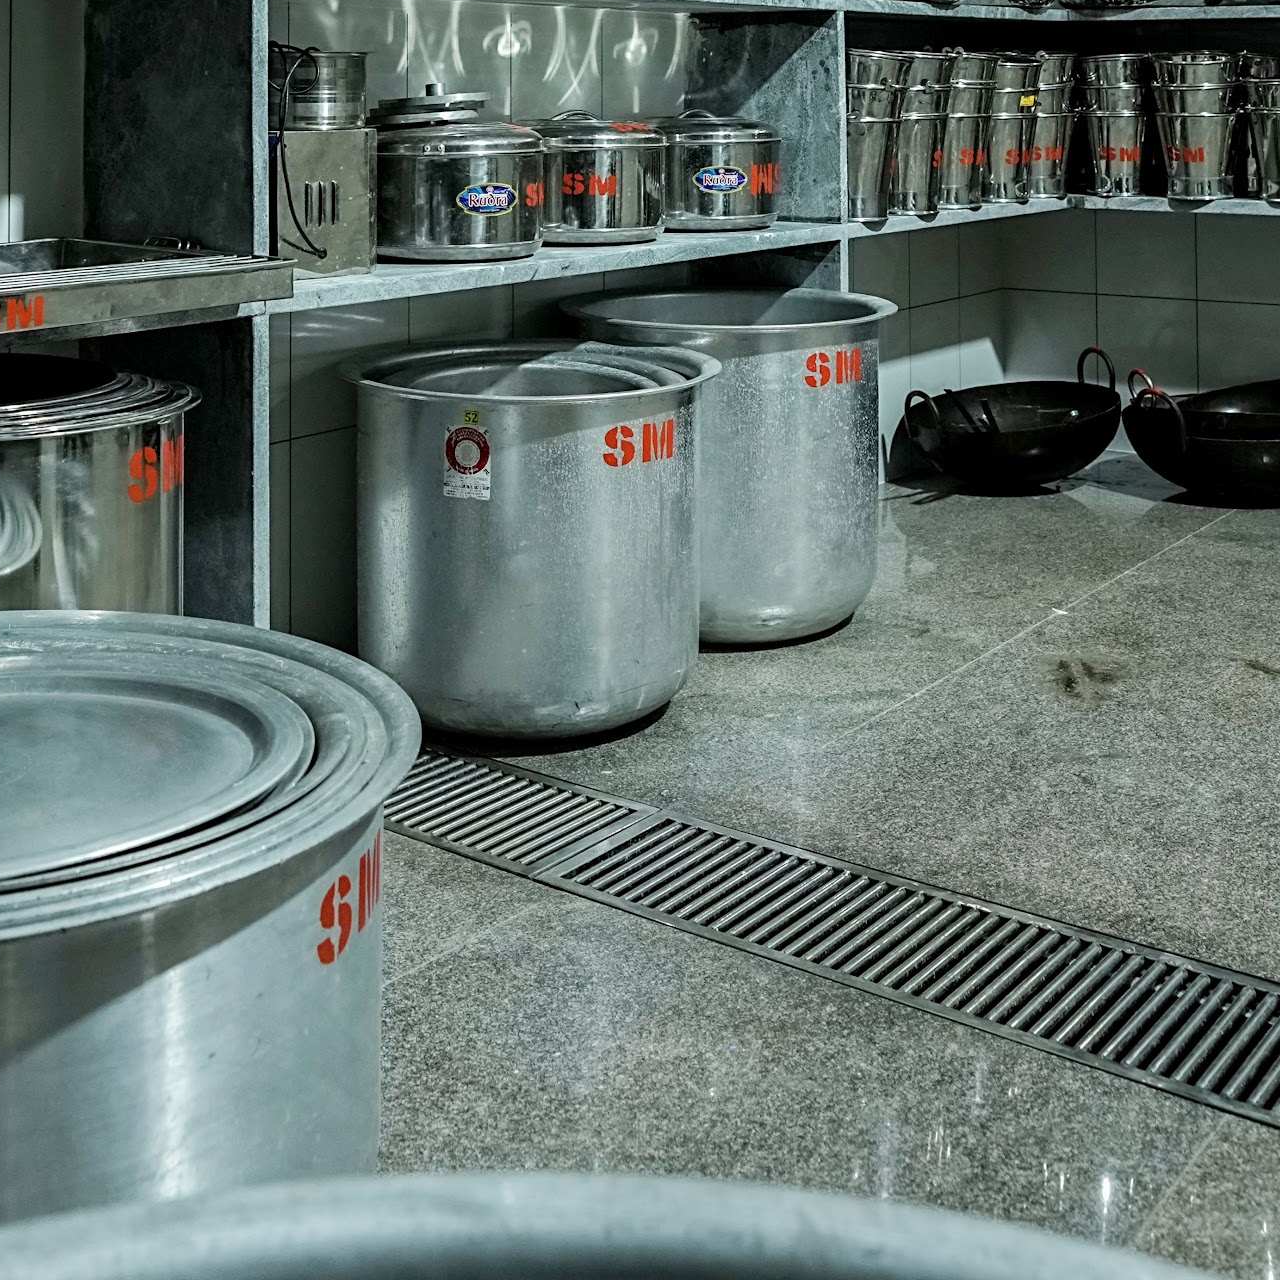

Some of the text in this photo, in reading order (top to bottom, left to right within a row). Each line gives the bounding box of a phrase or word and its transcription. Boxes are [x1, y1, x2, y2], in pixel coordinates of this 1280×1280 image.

[1031, 146, 1062, 162] SM
[1100, 146, 1140, 162] SM
[1169, 147, 1205, 163] SM
[562, 173, 617, 197] SM
[703, 173, 739, 187] Rudra
[468, 190, 509, 207] Rudra
[804, 347, 862, 389] SM
[465, 412, 478, 423] 52
[603, 419, 674, 468] SM
[127, 434, 184, 504] SM
[317, 831, 382, 965] SM
